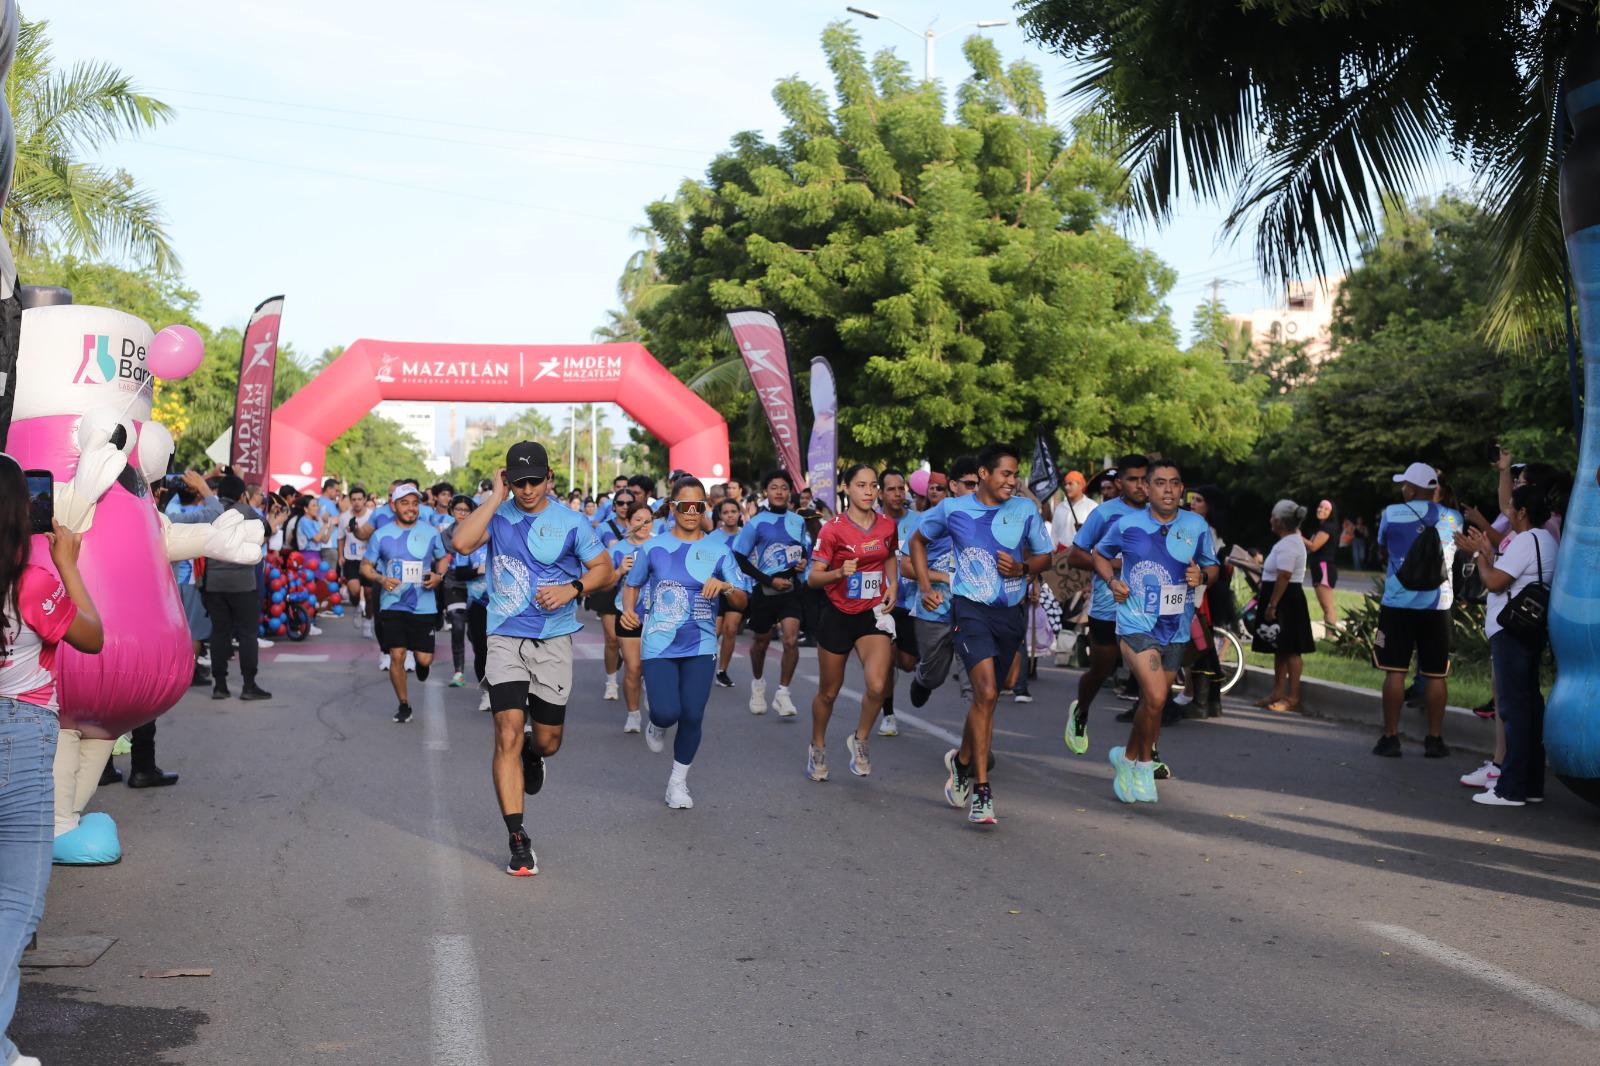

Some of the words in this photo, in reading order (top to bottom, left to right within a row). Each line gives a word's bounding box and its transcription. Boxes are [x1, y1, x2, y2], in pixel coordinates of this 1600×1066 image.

[402, 359, 509, 377] MAZATLÁN
[564, 356, 622, 369] IMDEM
[236, 383, 254, 473] IMDEM
[406, 567, 419, 575] 111
[850, 578, 860, 590] 9
[1148, 592, 1158, 604] 9
[1164, 594, 1183, 604] 186
